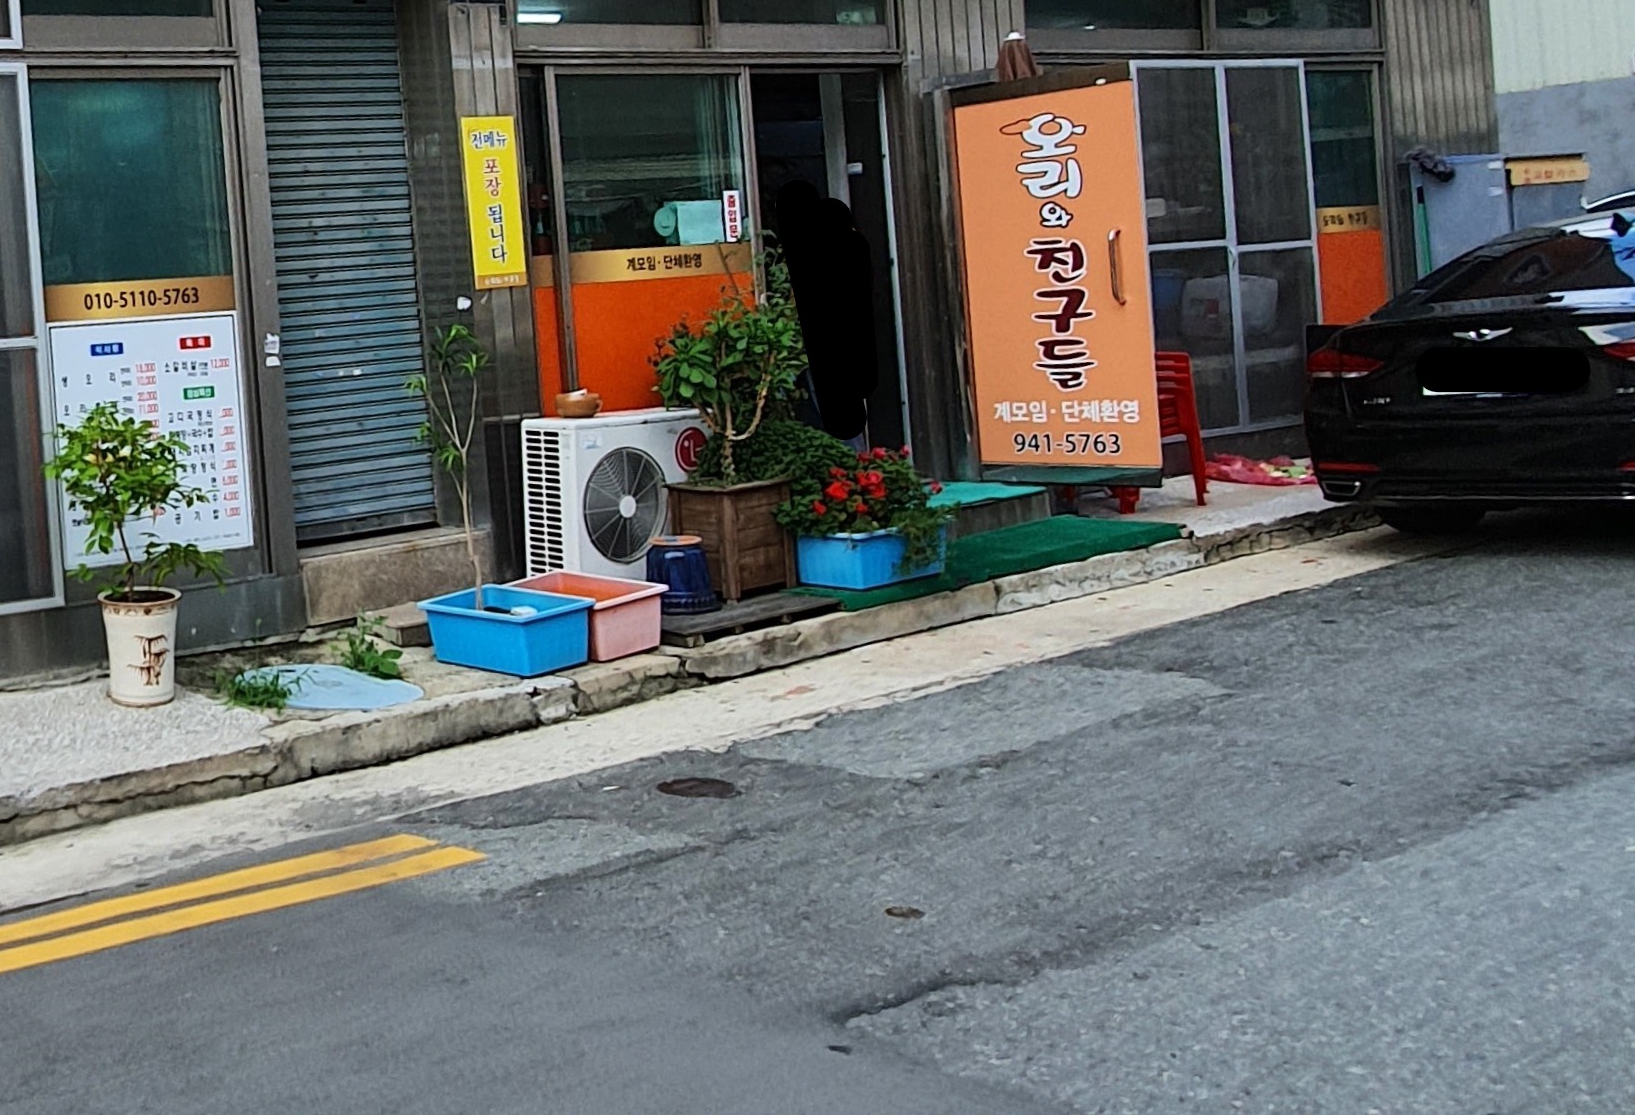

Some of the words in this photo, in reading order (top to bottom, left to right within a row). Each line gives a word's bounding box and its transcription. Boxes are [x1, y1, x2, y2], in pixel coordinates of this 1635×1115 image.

[470, 130, 508, 151] 전메뉴
[483, 158, 502, 198] 포장
[999, 111, 1087, 228] 오리와
[487, 203, 508, 264] 됩니다
[83, 286, 200, 311] 010-5110-5763
[1023, 236, 1099, 394] 친구들
[1013, 432, 1122, 455] 941-5763
